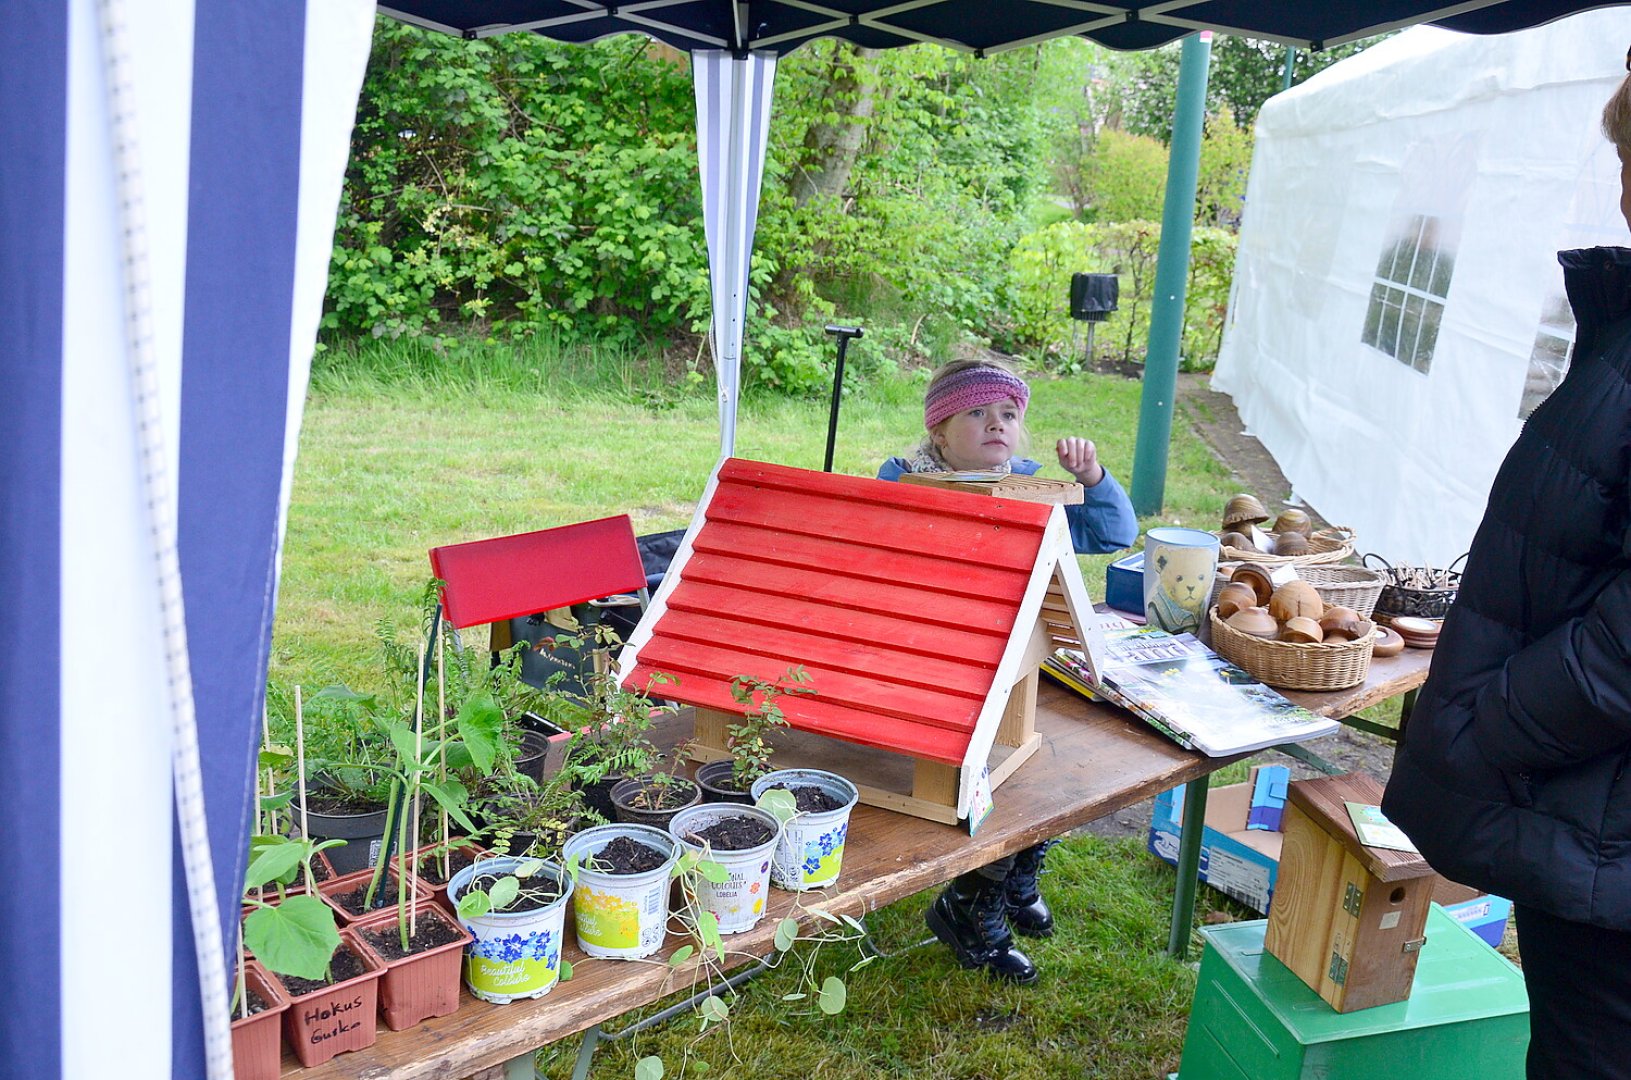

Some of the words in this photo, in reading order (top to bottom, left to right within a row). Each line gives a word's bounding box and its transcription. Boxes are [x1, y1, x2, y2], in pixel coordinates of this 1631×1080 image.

[716, 890, 738, 898] LOBELIA
[480, 960, 525, 977] Beautiful
[304, 995, 363, 1027] Hokus
